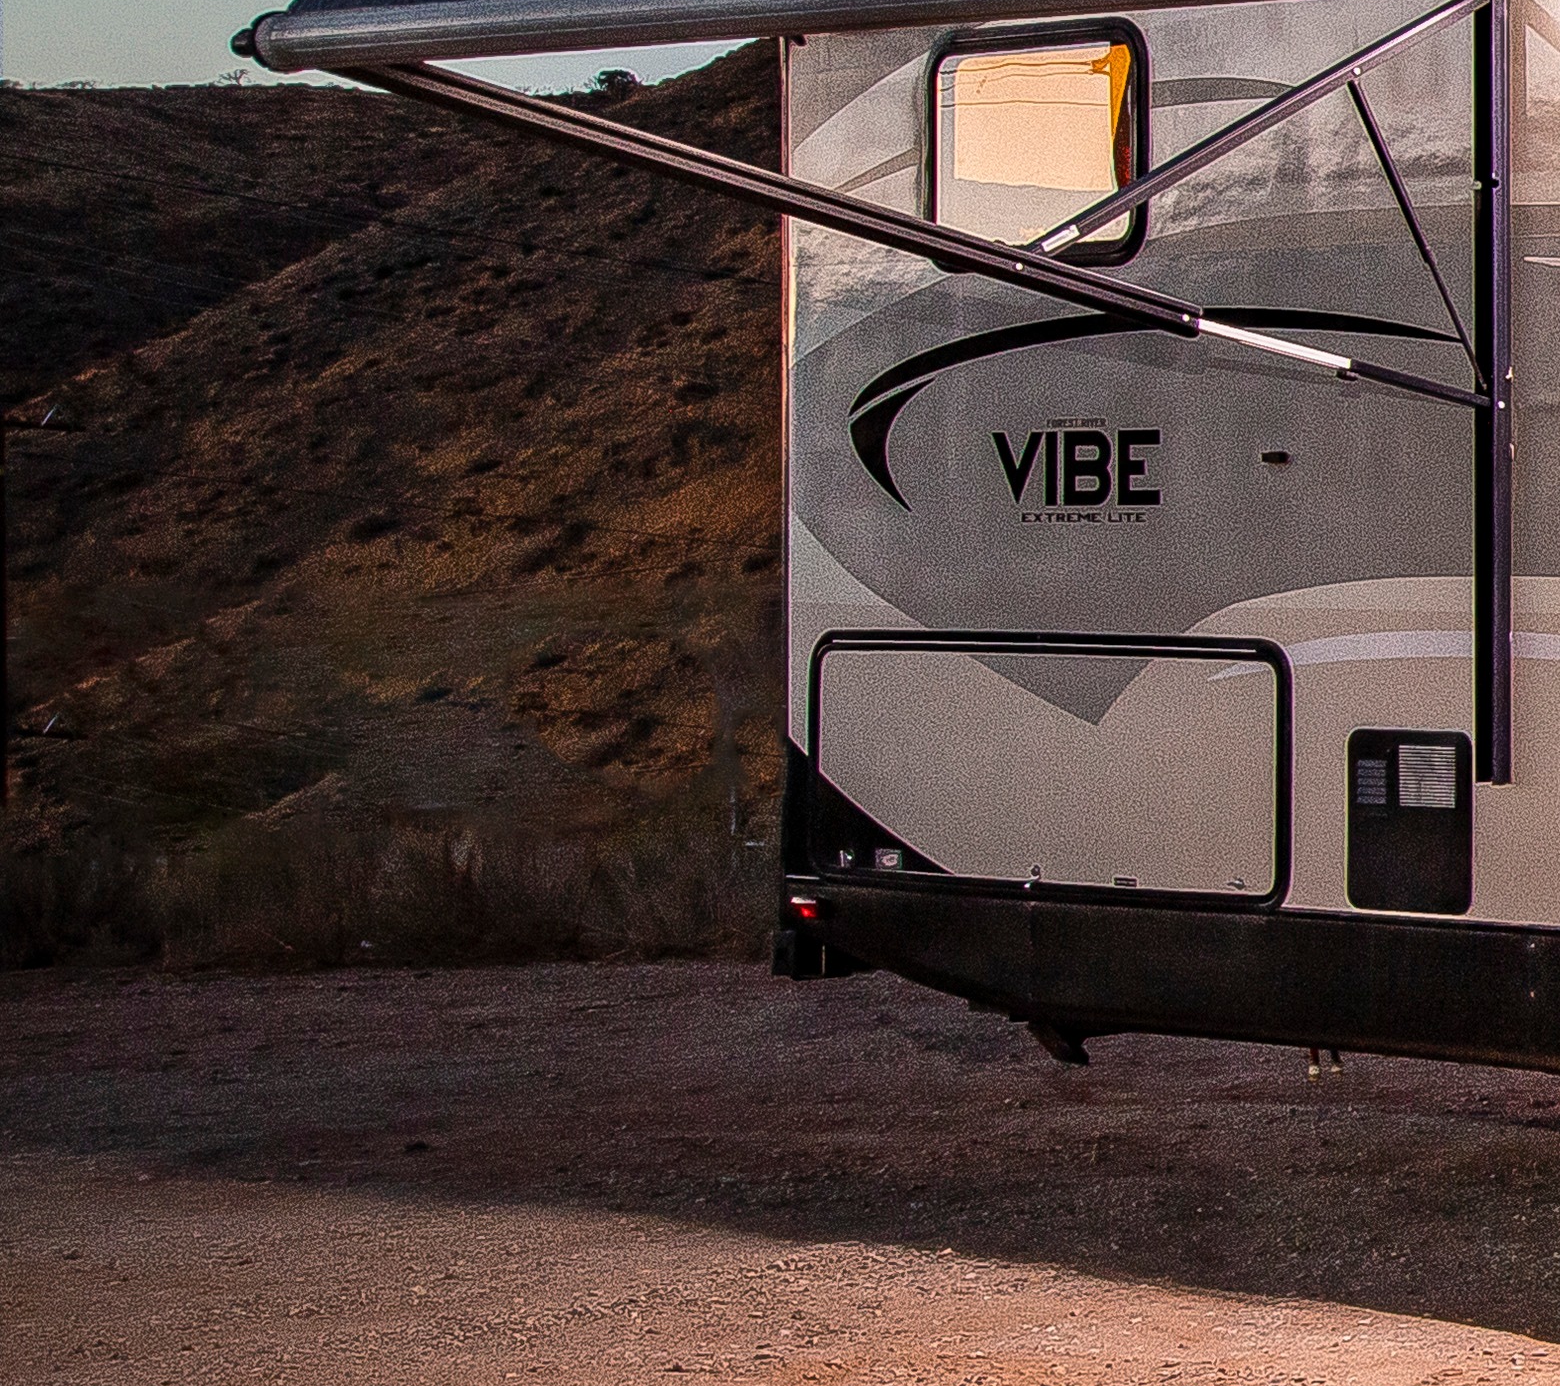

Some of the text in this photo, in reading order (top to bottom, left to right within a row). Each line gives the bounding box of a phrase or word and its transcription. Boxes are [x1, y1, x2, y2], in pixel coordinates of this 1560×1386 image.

[1046, 417, 1106, 428] FOREST RIVER
[991, 430, 1161, 506] VIBE
[1021, 512, 1146, 523] EXTREME LITE
